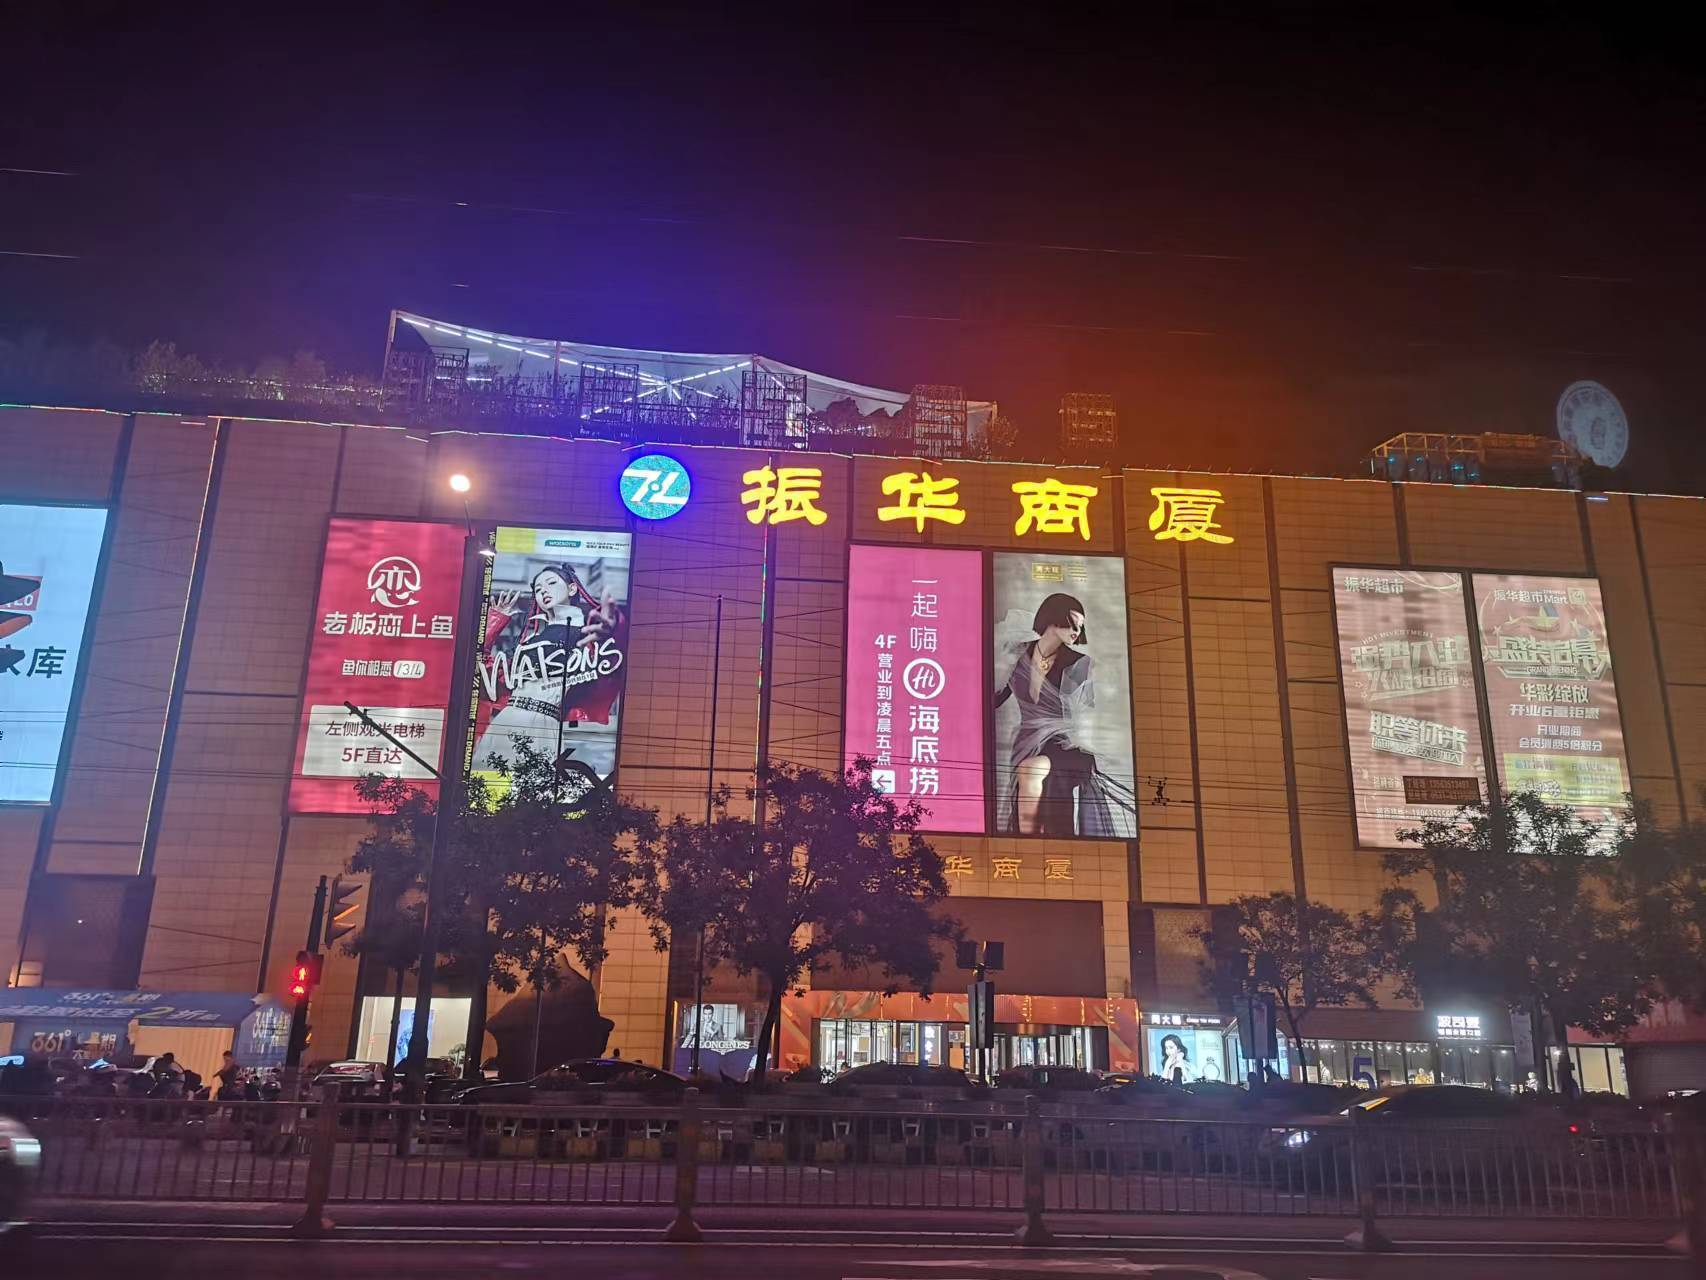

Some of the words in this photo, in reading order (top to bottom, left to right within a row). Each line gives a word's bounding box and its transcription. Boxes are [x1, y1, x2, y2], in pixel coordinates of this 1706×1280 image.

[741, 466, 1235, 544] 振华商厦
[1344, 576, 1404, 595] 振华超市
[1494, 589, 1543, 604] 振华超市
[1544, 593, 1569, 605] Mart
[323, 611, 454, 639] 老板恋上鱼
[910, 579, 938, 653] 一起嗨
[874, 634, 897, 649] 4F
[479, 637, 623, 702] WATSONS
[1520, 682, 1589, 704] 华彩绽放
[876, 652, 893, 766] 营业到凌晨五点
[325, 720, 425, 739] 左侧观光电梯
[1369, 710, 1468, 753] 职等你来
[1537, 724, 1582, 737] 开业期间
[341, 747, 403, 765] 5F直达
[909, 705, 940, 795] 海底捞
[892, 855, 1074, 880] 华商厦
[699, 1040, 751, 1049] LONGINES
